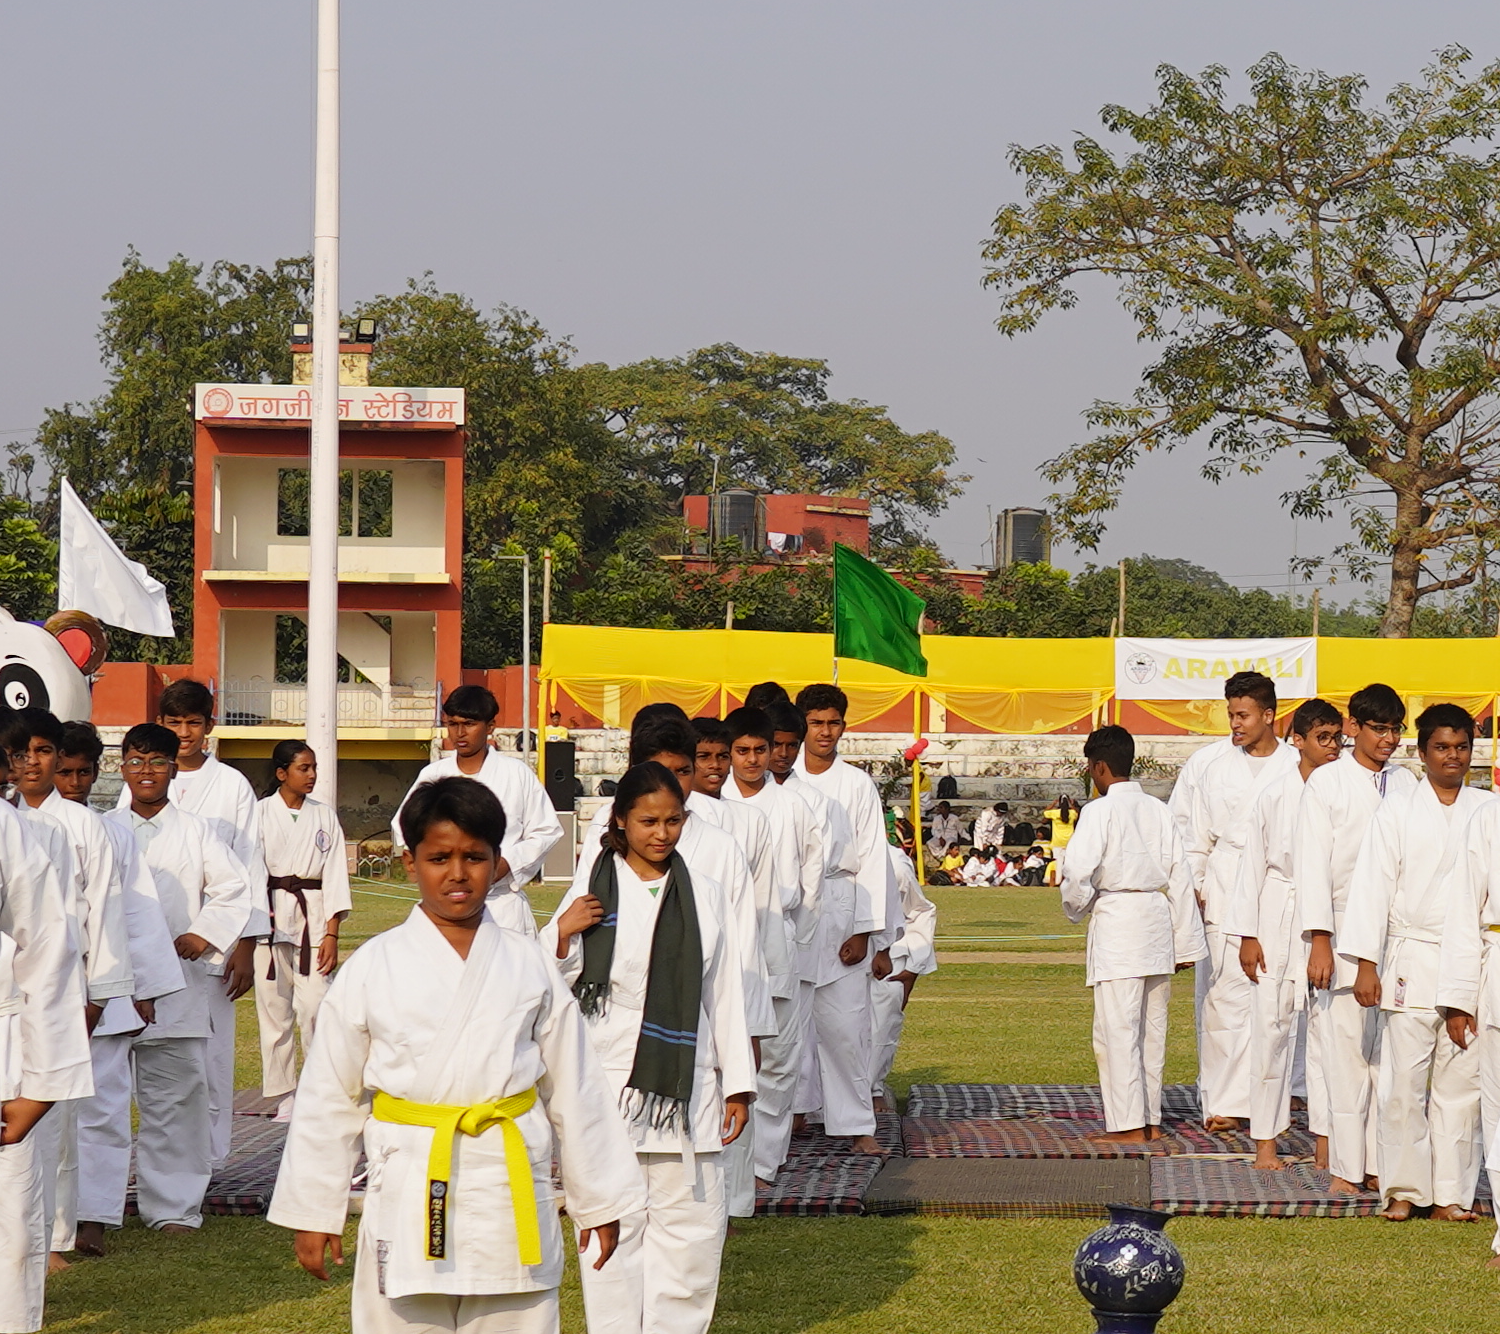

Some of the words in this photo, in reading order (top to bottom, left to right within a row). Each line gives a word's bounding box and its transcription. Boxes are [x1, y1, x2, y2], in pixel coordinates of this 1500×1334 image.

[237, 389, 354, 417] जगजीन
[362, 392, 459, 420] स्टेडियम
[1162, 657, 1303, 679] ARAVALI
